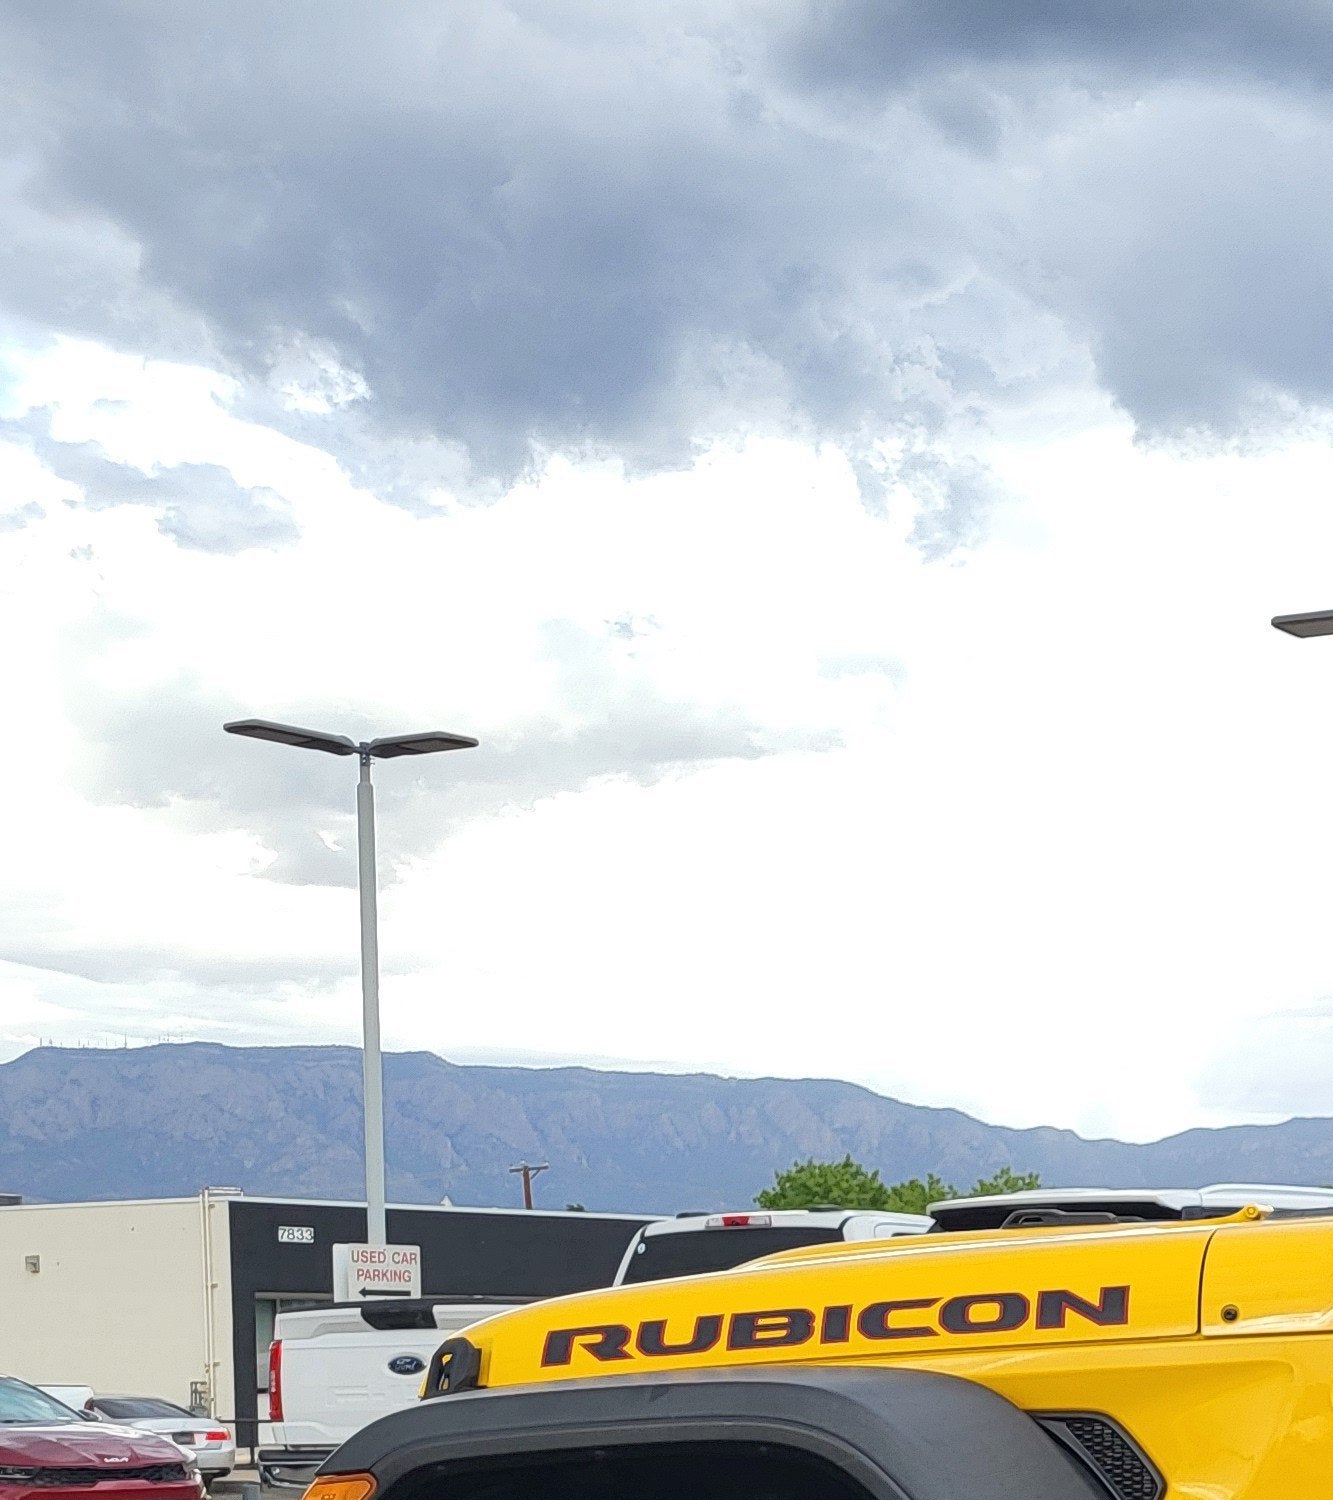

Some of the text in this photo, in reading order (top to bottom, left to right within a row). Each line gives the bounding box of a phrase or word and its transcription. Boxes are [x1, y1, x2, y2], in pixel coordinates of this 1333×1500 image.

[279, 1228, 314, 1241] 7833
[351, 1250, 417, 1265] USED CAR
[356, 1268, 411, 1282] PARKING
[540, 1285, 1130, 1368] RUBICON
